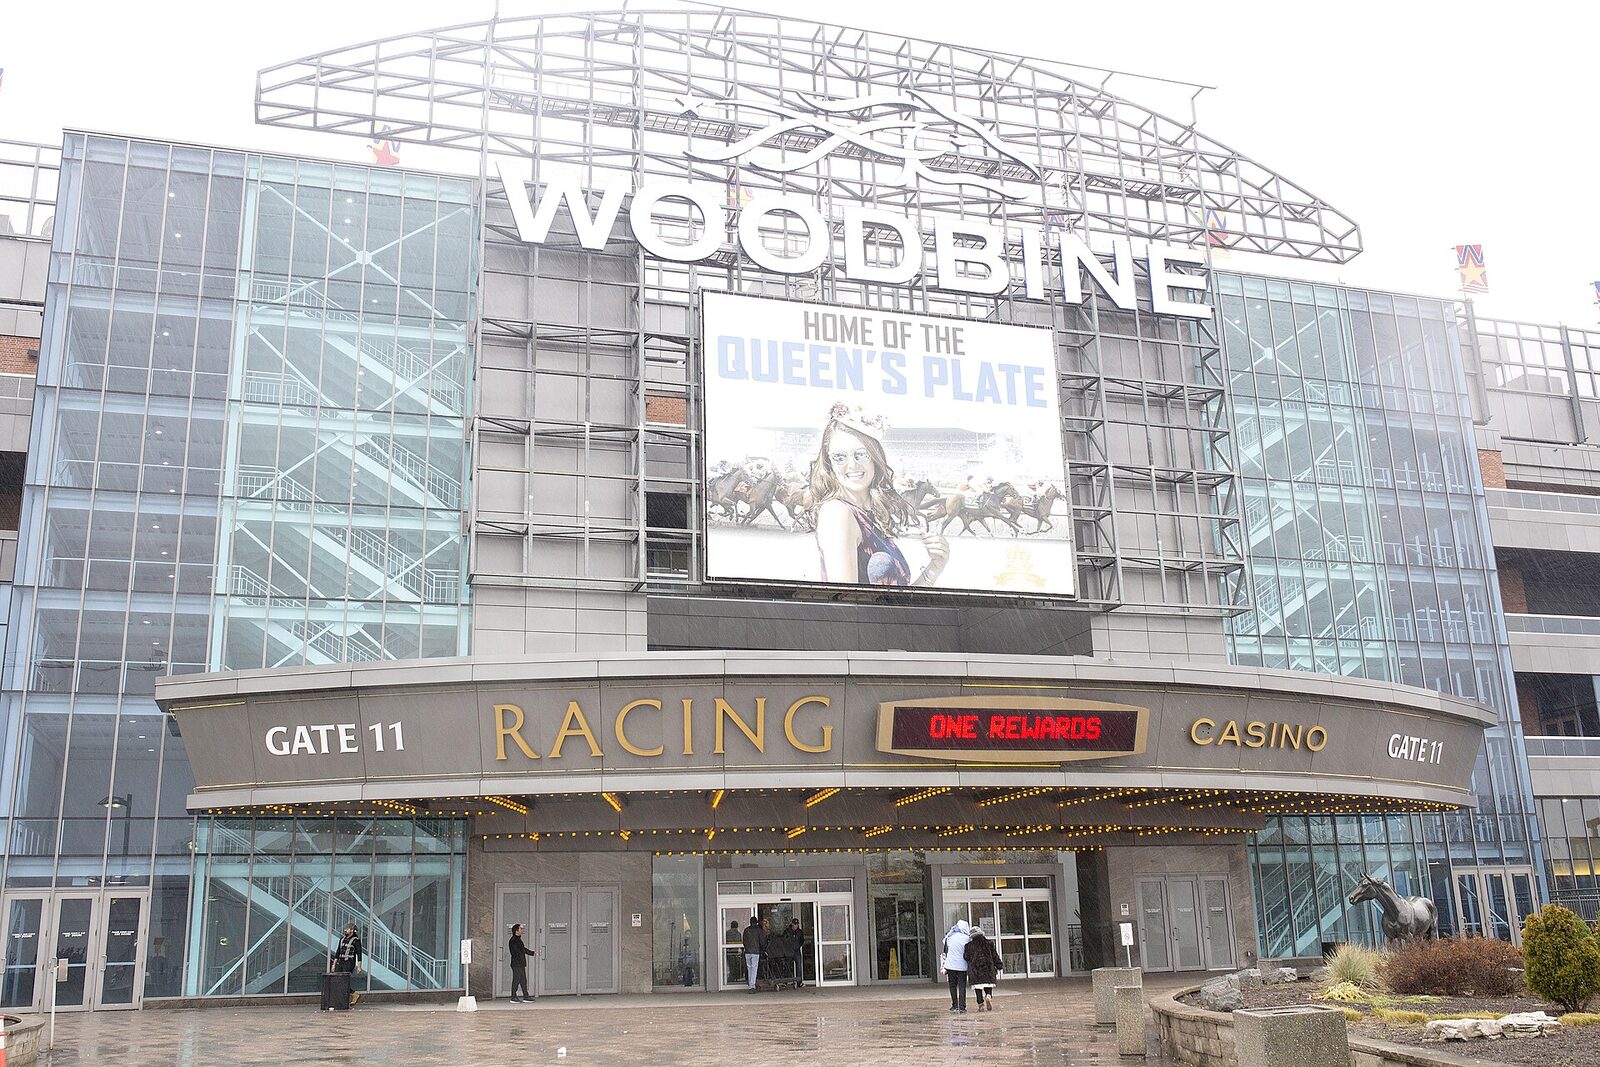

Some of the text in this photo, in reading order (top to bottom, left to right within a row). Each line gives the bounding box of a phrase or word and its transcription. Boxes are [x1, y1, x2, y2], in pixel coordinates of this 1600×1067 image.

[495, 161, 1212, 319] WOODBINE
[803, 310, 966, 356] HOME OF THE
[717, 335, 1048, 408] QUEEN'S PLATE
[265, 719, 406, 756] GATE 11
[494, 697, 833, 760] RACING
[929, 713, 1102, 741] ONE REWARDS
[1190, 717, 1329, 754] CASINO
[1388, 733, 1444, 764] GATE 11
